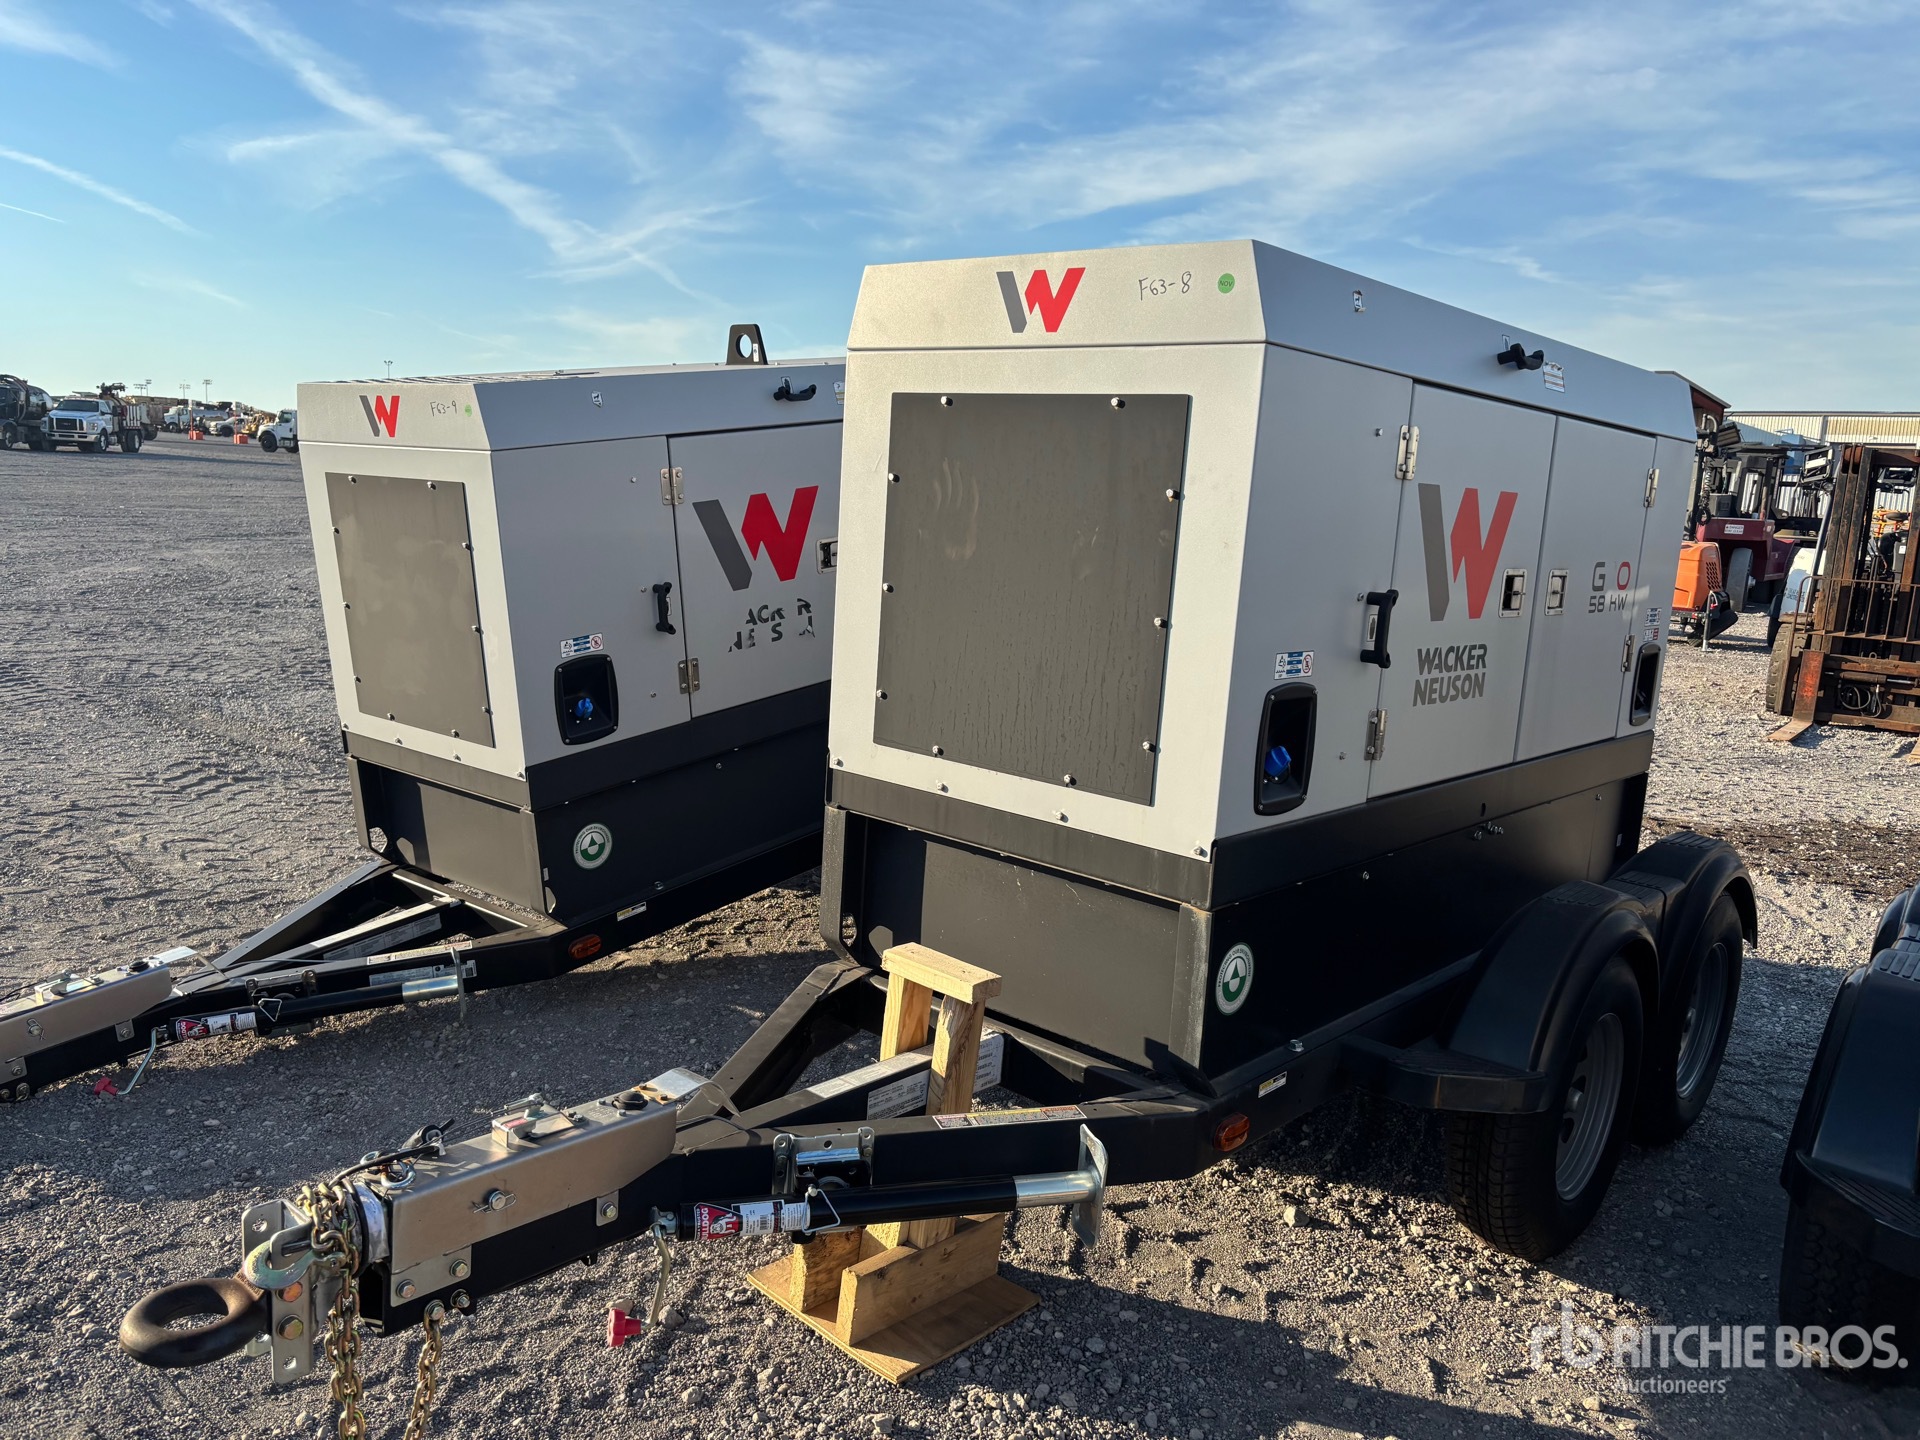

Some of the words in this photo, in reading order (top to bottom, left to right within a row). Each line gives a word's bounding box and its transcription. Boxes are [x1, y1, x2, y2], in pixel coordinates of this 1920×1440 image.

[1138, 271, 1193, 301] F63-8
[429, 400, 458, 417] F63-9
[1587, 594, 1606, 614] 58
[1417, 643, 1488, 676] WACKER
[1412, 672, 1486, 707] NEUSON
